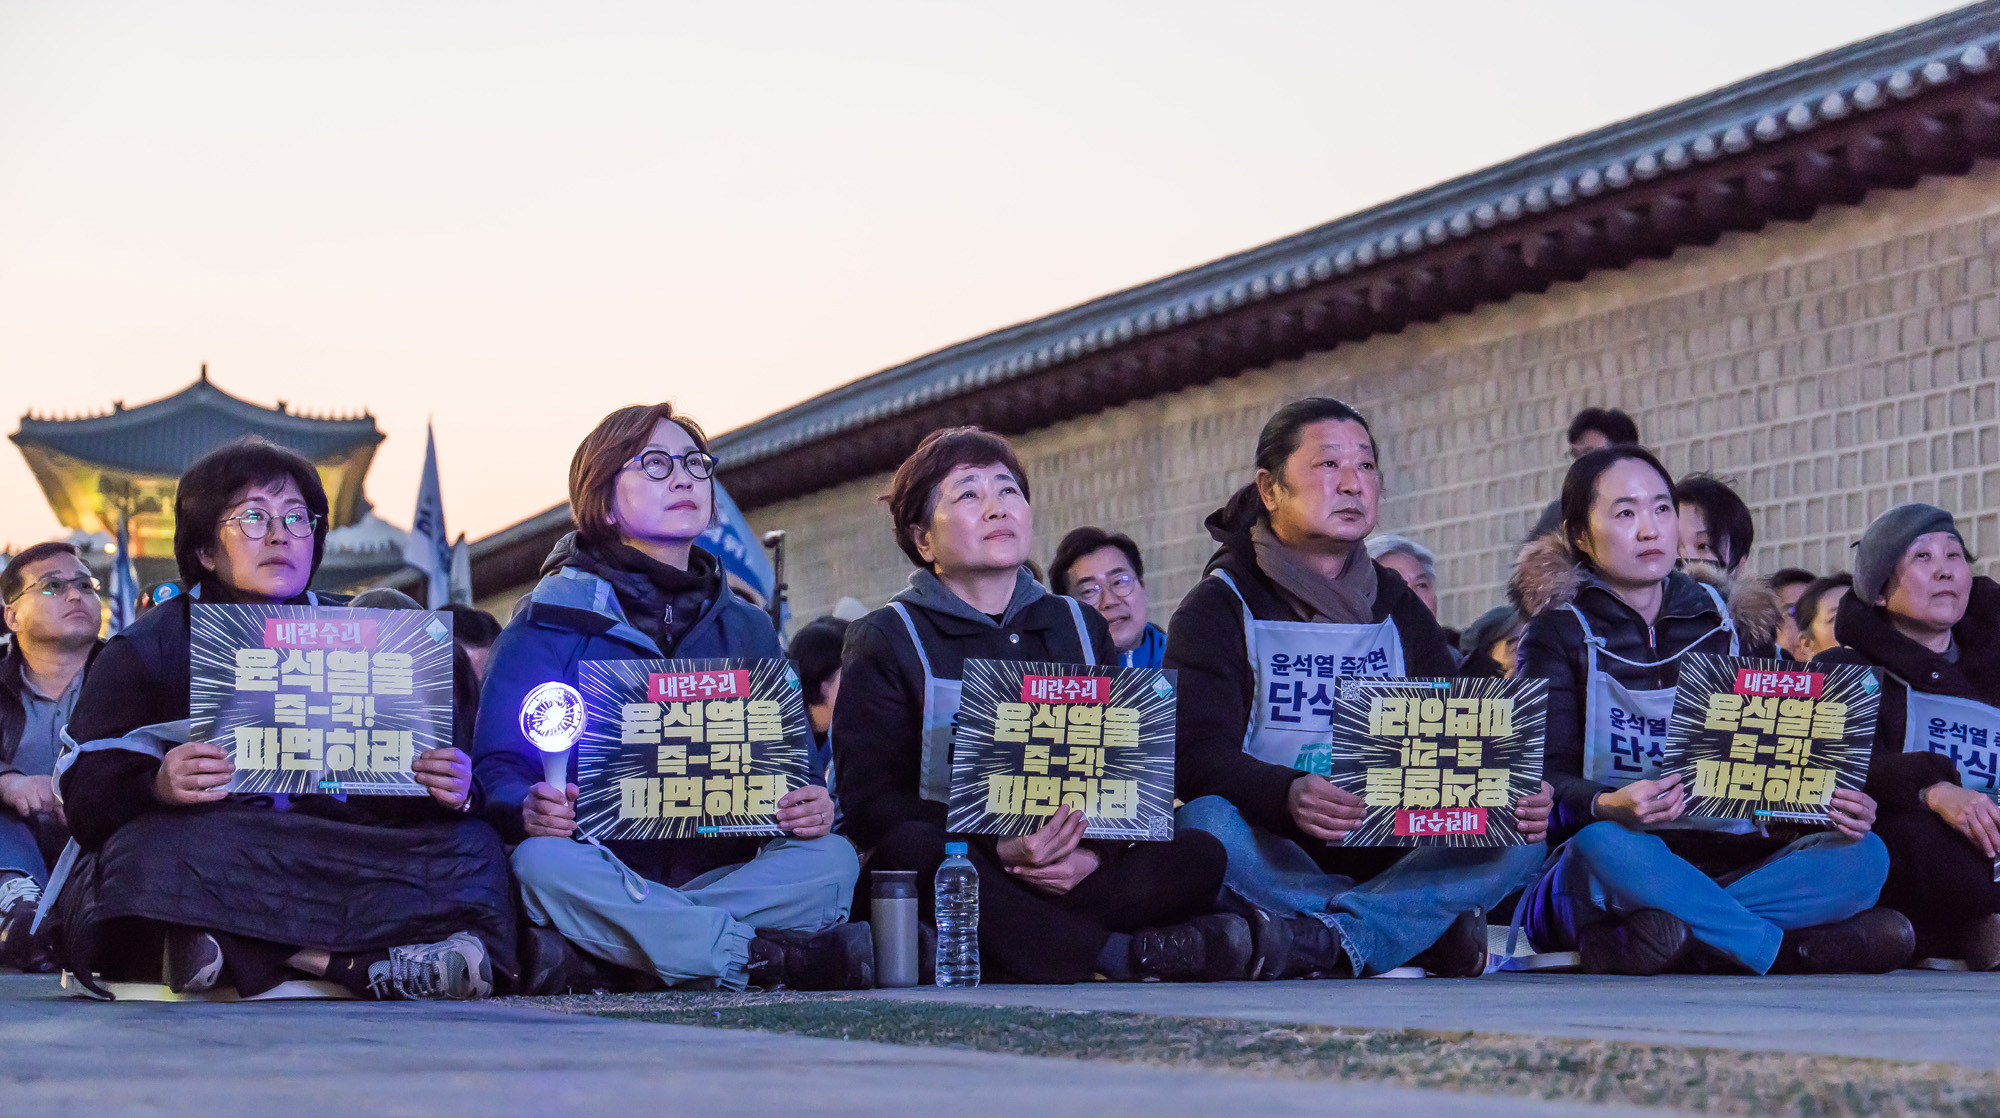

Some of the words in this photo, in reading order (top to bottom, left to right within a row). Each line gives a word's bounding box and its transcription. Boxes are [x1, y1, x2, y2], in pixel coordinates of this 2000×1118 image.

[276, 622, 362, 645] 내란수괴
[235, 649, 413, 694] 윤석열을
[658, 672, 737, 698] 내란수괴
[1271, 653, 1334, 678] 윤석열
[1744, 672, 1812, 695] 내란수괴
[1031, 679, 1098, 700] 내란수괴
[621, 700, 783, 744] 윤석열을
[994, 702, 1140, 747] 윤석열을
[1369, 697, 1514, 737] 파면하라
[1610, 707, 1666, 737] 윤석열
[1704, 693, 1848, 740] 윤석열을
[1928, 717, 1987, 748] 윤석열
[234, 727, 414, 772] 파면하라
[619, 774, 788, 819] 파면하라
[985, 775, 1140, 818] 파면하라
[1365, 768, 1510, 808] 윤석열을
[1692, 760, 1836, 806] 파면하라
[1409, 812, 1478, 833] 내란수괴
